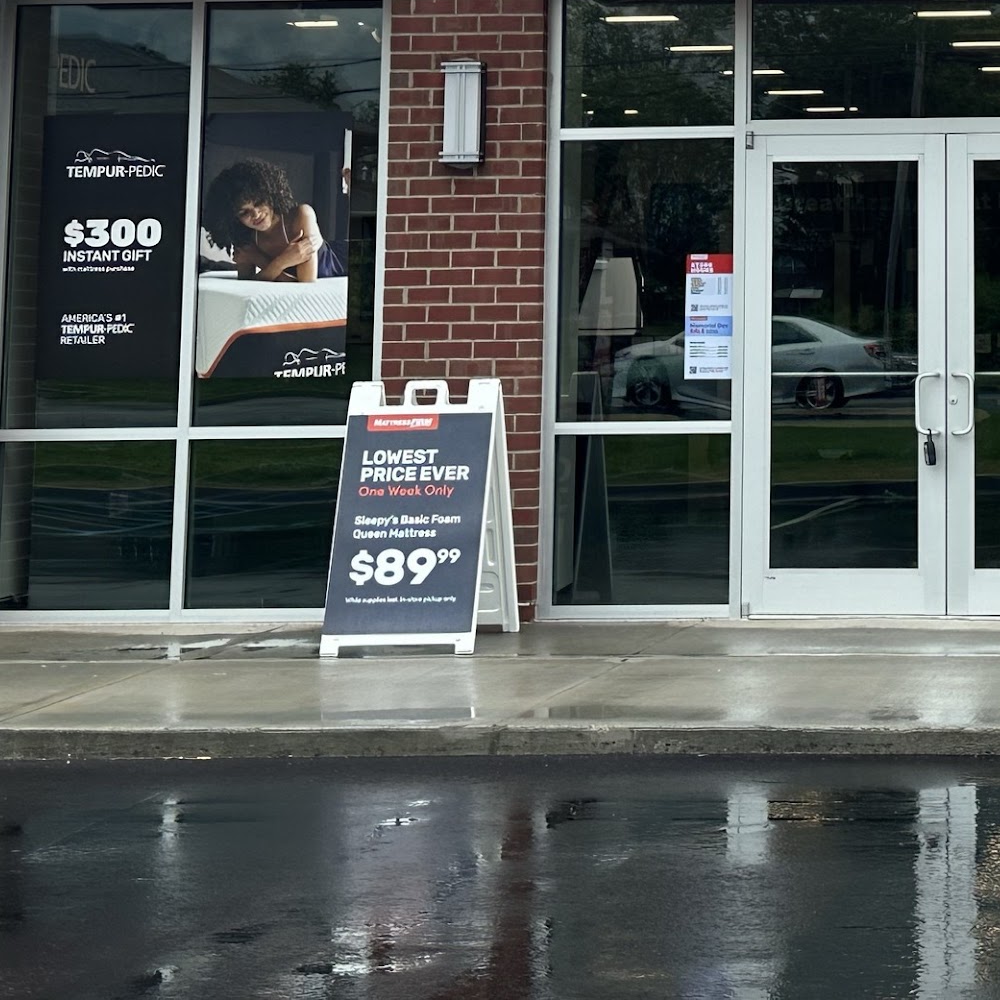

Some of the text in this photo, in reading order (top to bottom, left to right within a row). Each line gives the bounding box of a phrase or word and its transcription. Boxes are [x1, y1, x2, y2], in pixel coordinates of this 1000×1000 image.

[66, 165, 166, 178] TEMPUR-PEDIC
[64, 218, 162, 248] $300
[63, 249, 152, 262] INSTANT GIFT
[61, 313, 113, 323] AMERICA'S
[60, 335, 106, 345] RETAILER
[362, 449, 439, 466] LOWEST
[360, 465, 470, 482] PRICE EVER
[358, 484, 455, 498] One Week Only
[354, 514, 461, 527] Sleepy's Basic Foam
[352, 528, 437, 539] Queen Mattress
